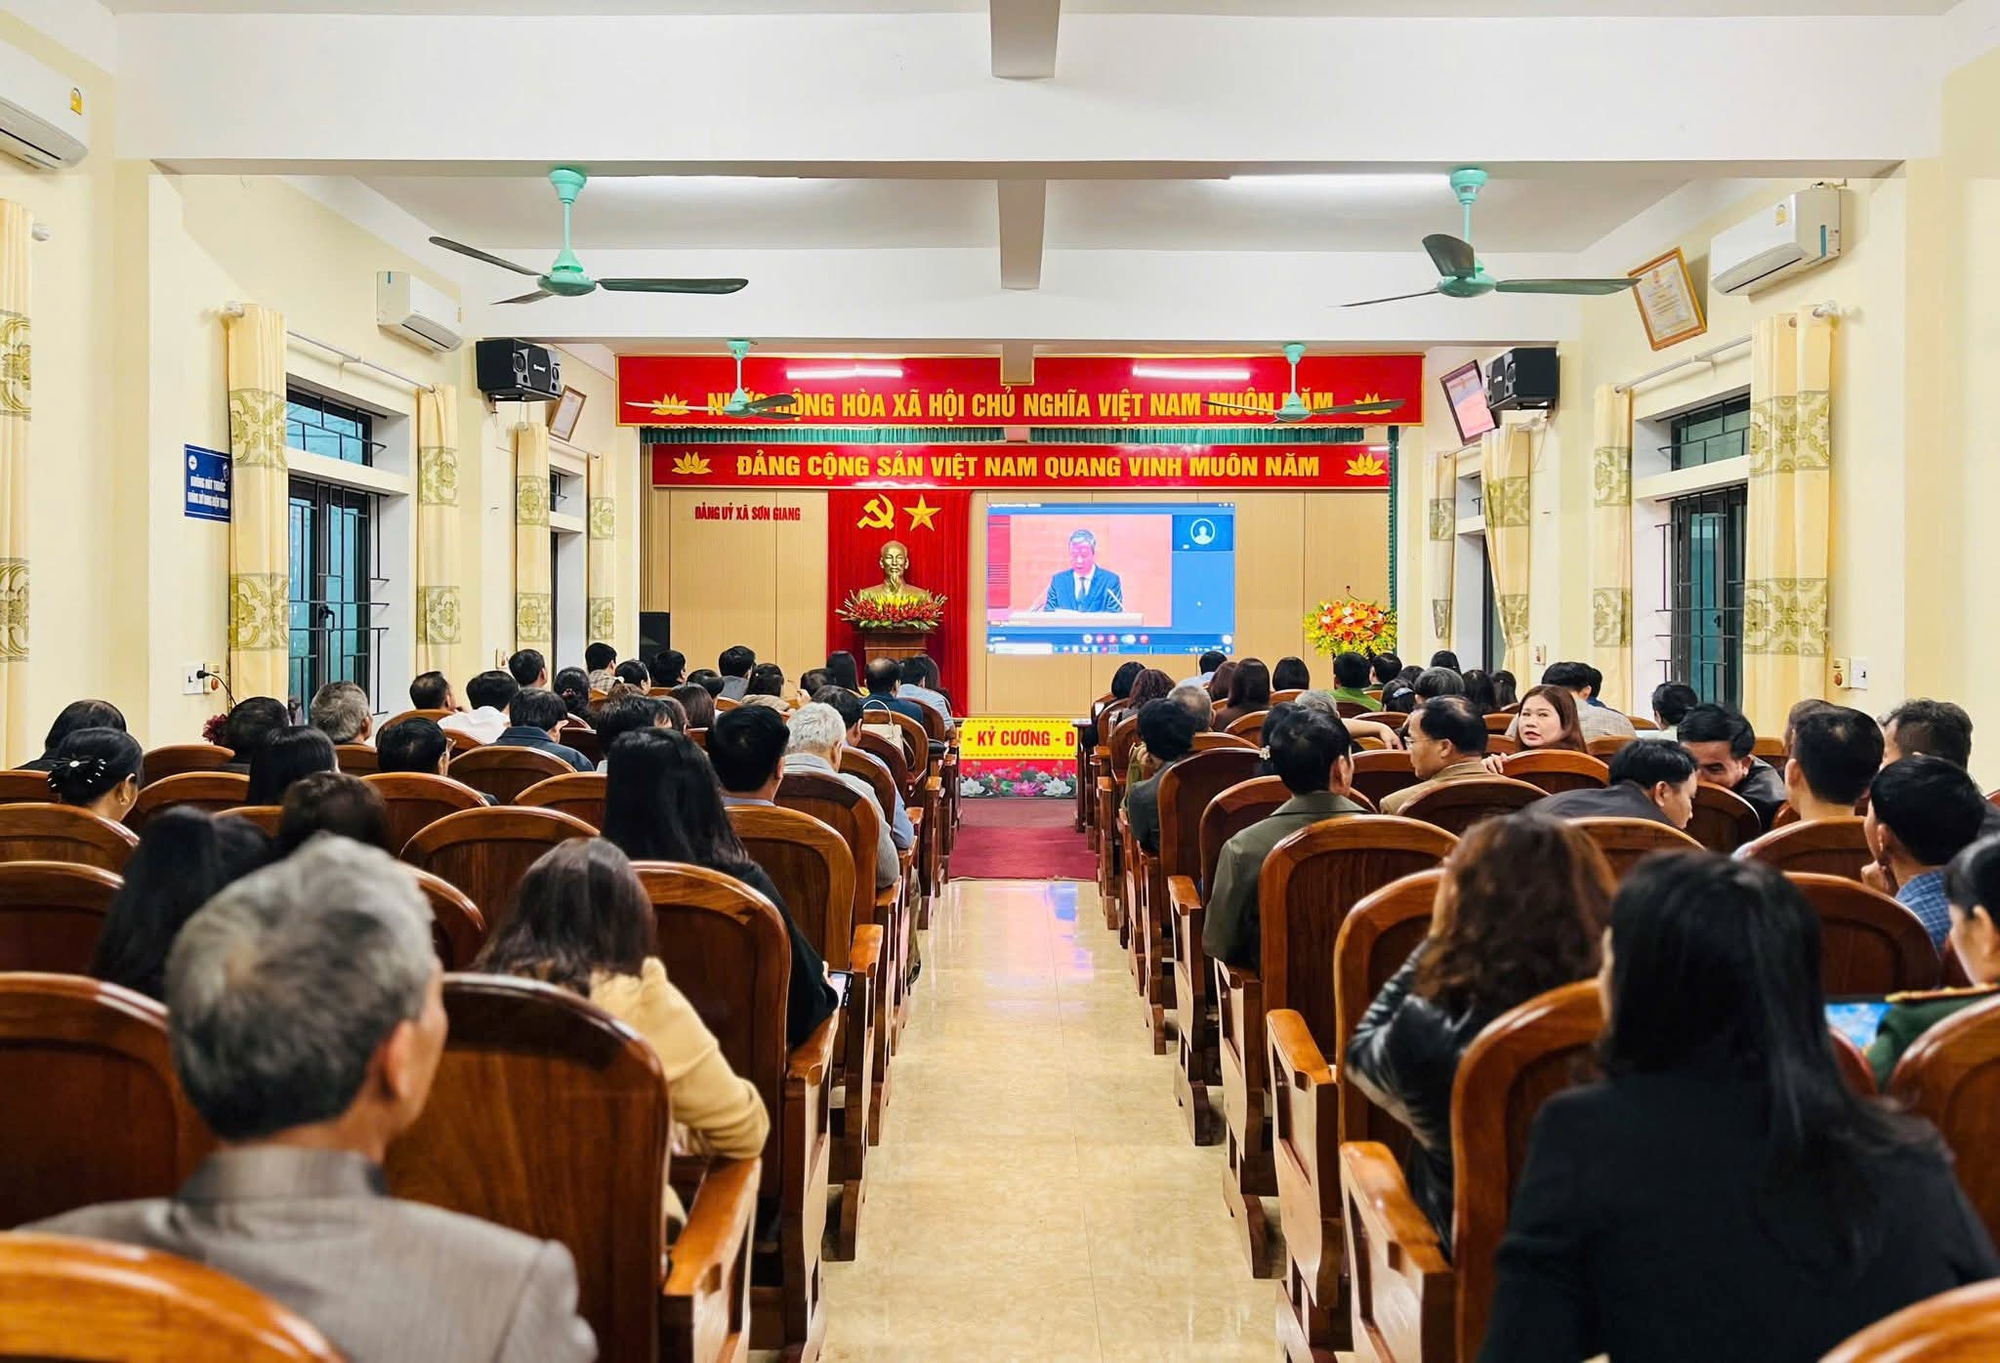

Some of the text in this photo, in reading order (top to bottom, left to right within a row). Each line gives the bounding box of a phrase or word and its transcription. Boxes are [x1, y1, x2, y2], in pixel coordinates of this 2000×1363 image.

[841, 389, 886, 417] HÒA
[893, 388, 922, 417] XÃ
[929, 388, 965, 421] HỘI
[973, 385, 1015, 417] CHỦ
[1023, 389, 1091, 417] NGHĨA
[1098, 388, 1144, 422] VIỆT
[1150, 392, 1201, 417] NAM
[1208, 387, 1275, 416] MUÔN
[736, 449, 1319, 479] ĐẢNG CỘNG SẢN VIỆT NAM QUANG VINH MUÔN NĂM
[736, 504, 749, 521] XÃ
[751, 505, 770, 521] SƠN
[772, 506, 801, 521] GIANG
[1000, 729, 1050, 747] CƯƠNG
